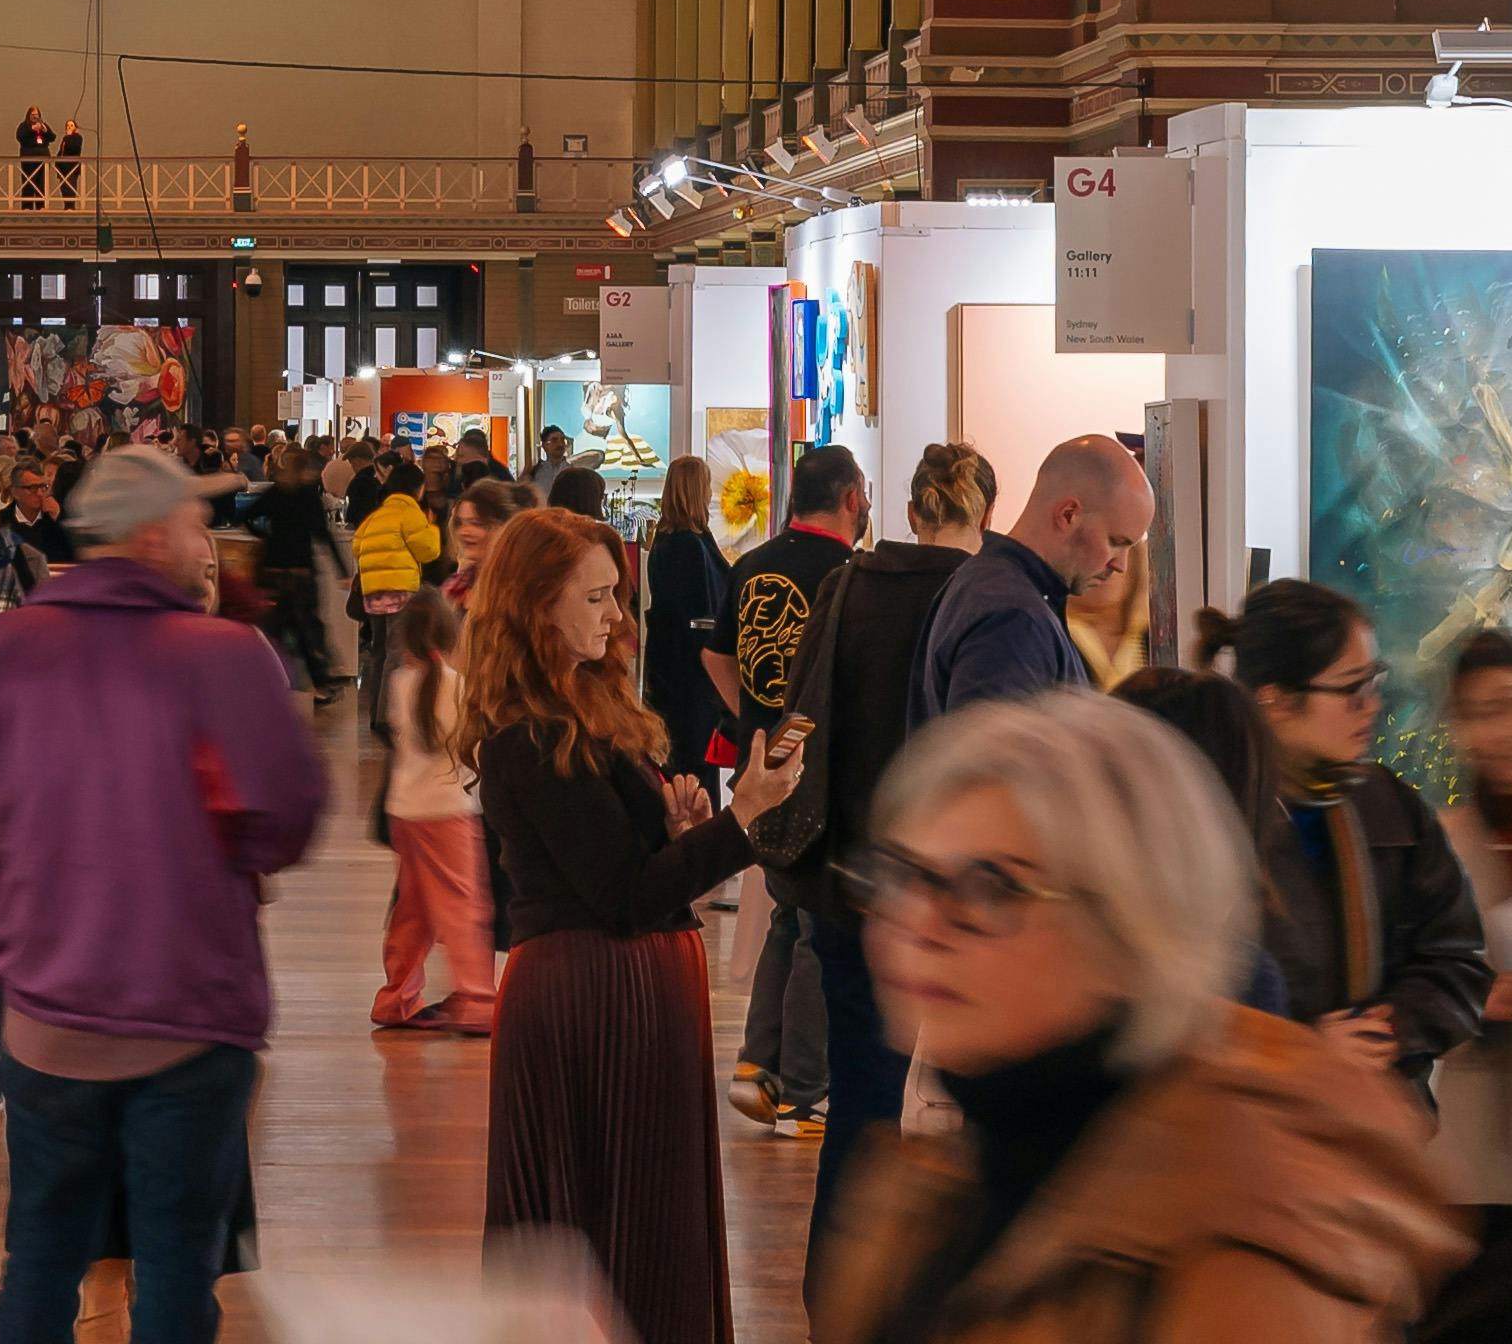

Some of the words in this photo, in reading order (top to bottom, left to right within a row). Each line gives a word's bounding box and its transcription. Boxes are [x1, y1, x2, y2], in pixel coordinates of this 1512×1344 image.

[1067, 168, 1116, 197] G4
[1066, 250, 1112, 264] Gallery
[1067, 267, 1098, 278] 11:11
[606, 292, 631, 307] G2
[1066, 319, 1098, 331] Sydney
[1066, 335, 1086, 344] New
[1089, 335, 1114, 344] South
[1116, 335, 1144, 344] Wales
